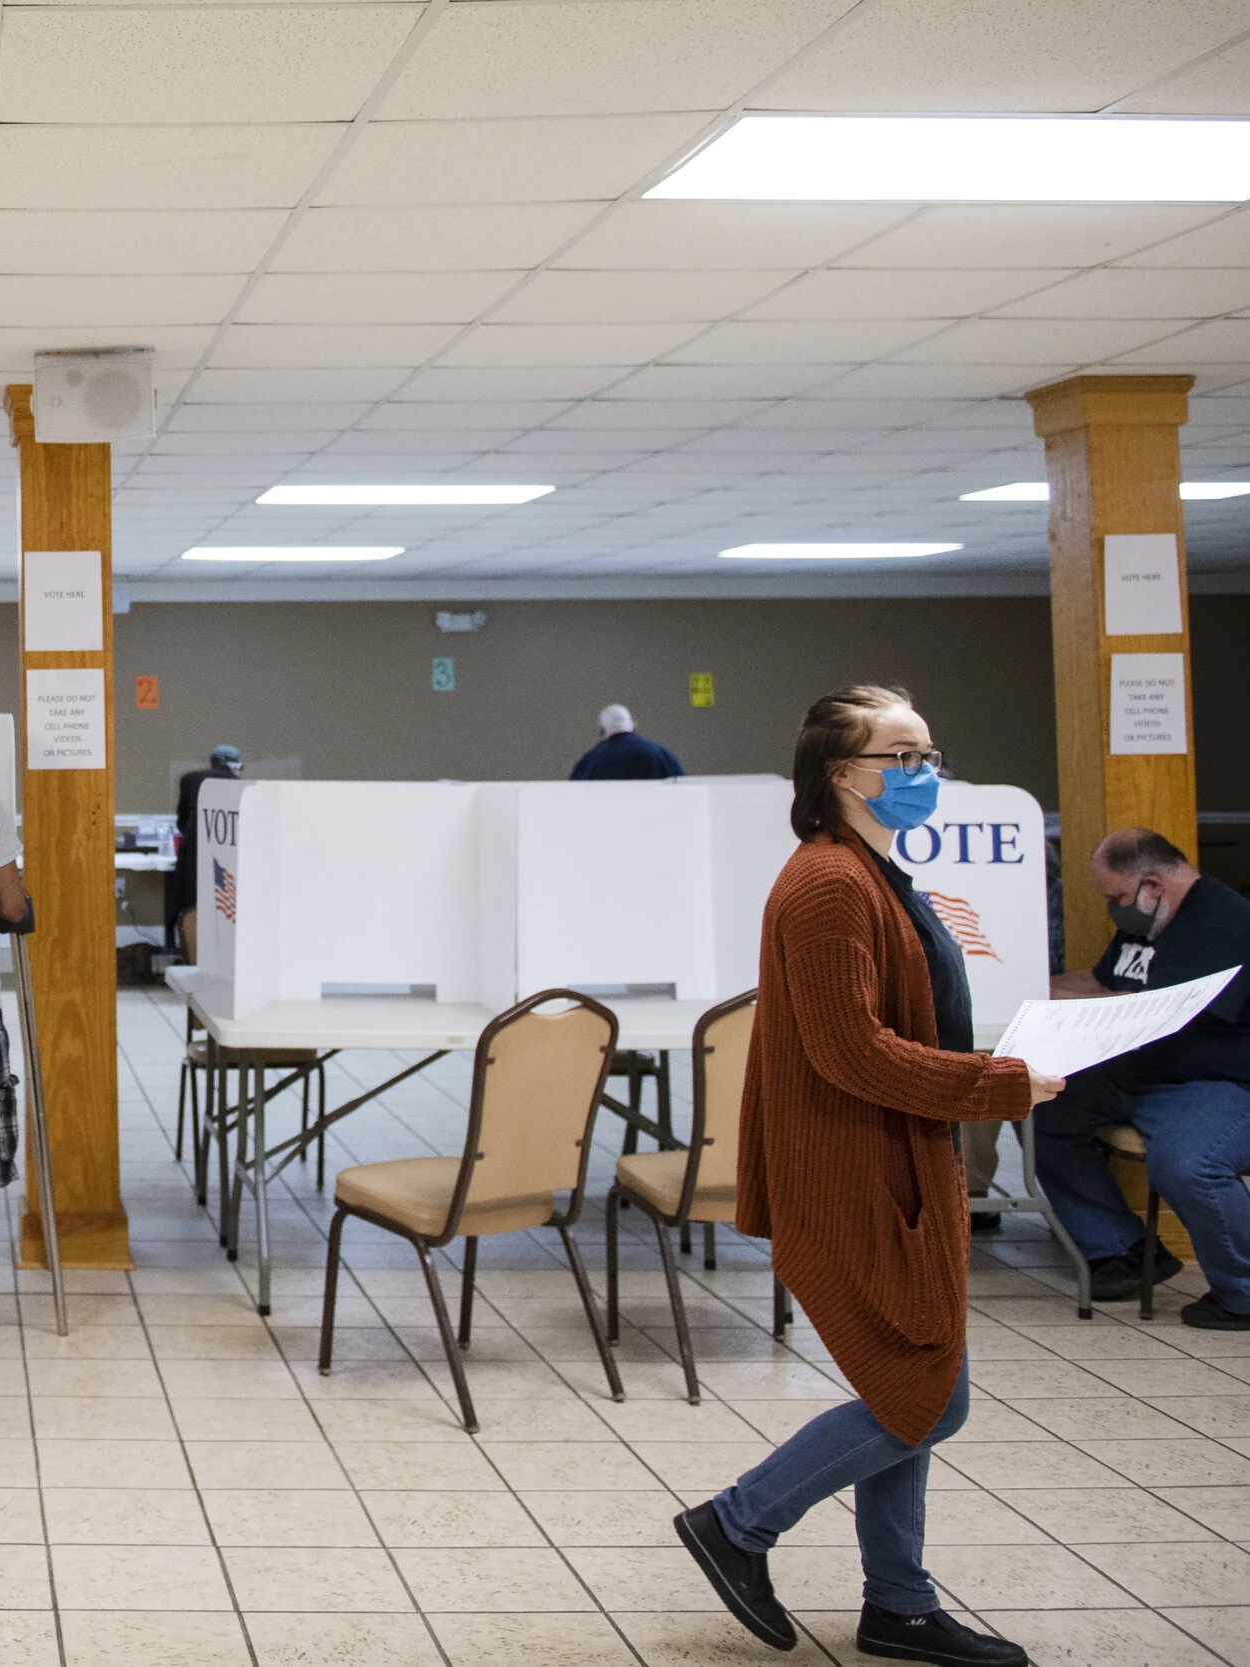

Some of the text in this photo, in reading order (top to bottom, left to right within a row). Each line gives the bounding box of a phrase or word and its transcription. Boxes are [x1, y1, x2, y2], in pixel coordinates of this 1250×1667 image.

[44, 590, 85, 599] VOTE HERE
[434, 659, 450, 688] 3
[137, 678, 156, 704] 2
[37, 695, 64, 703] PLEASE
[49, 709, 67, 717] TAKE
[44, 722, 91, 731] CELL PHONE
[53, 735, 82, 743] VIDEOS
[43, 749, 92, 757] OR PICTURES
[203, 808, 239, 846] VOT
[896, 822, 1024, 865] OTE
